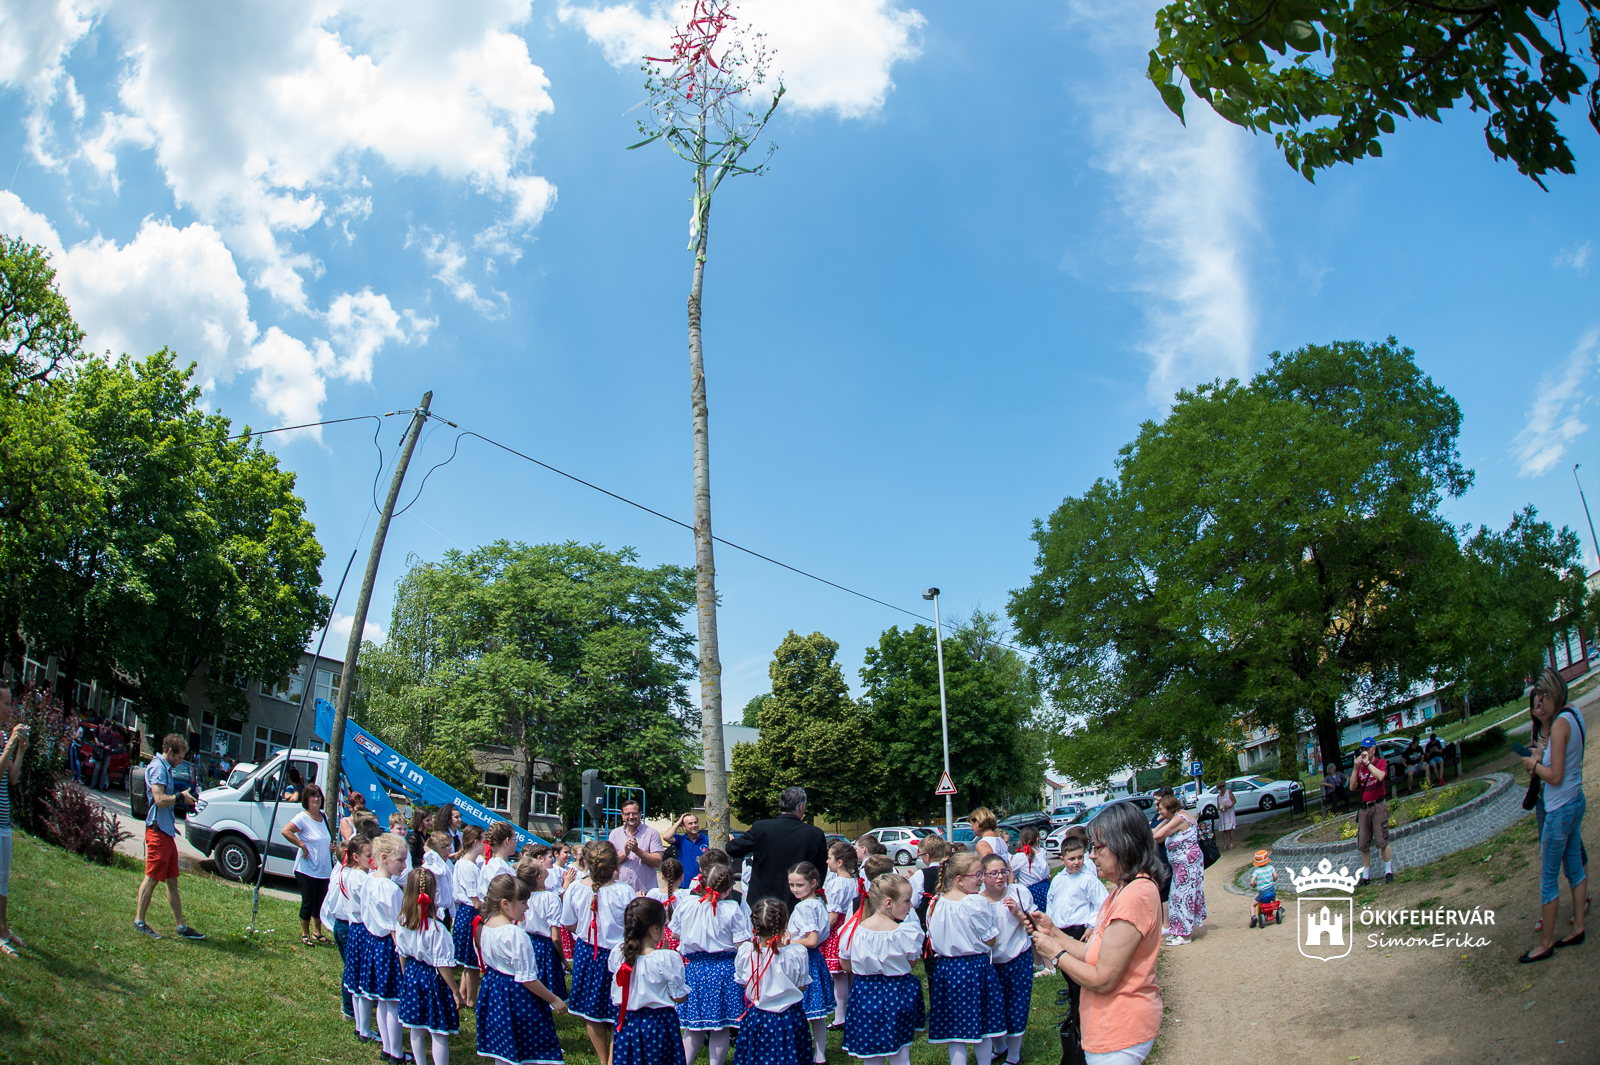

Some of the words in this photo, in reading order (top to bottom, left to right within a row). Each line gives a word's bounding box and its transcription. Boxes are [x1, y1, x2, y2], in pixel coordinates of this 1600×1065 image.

[387, 754, 408, 774] 21
[407, 769, 424, 785] m
[453, 797, 498, 826] BÉRELHE
